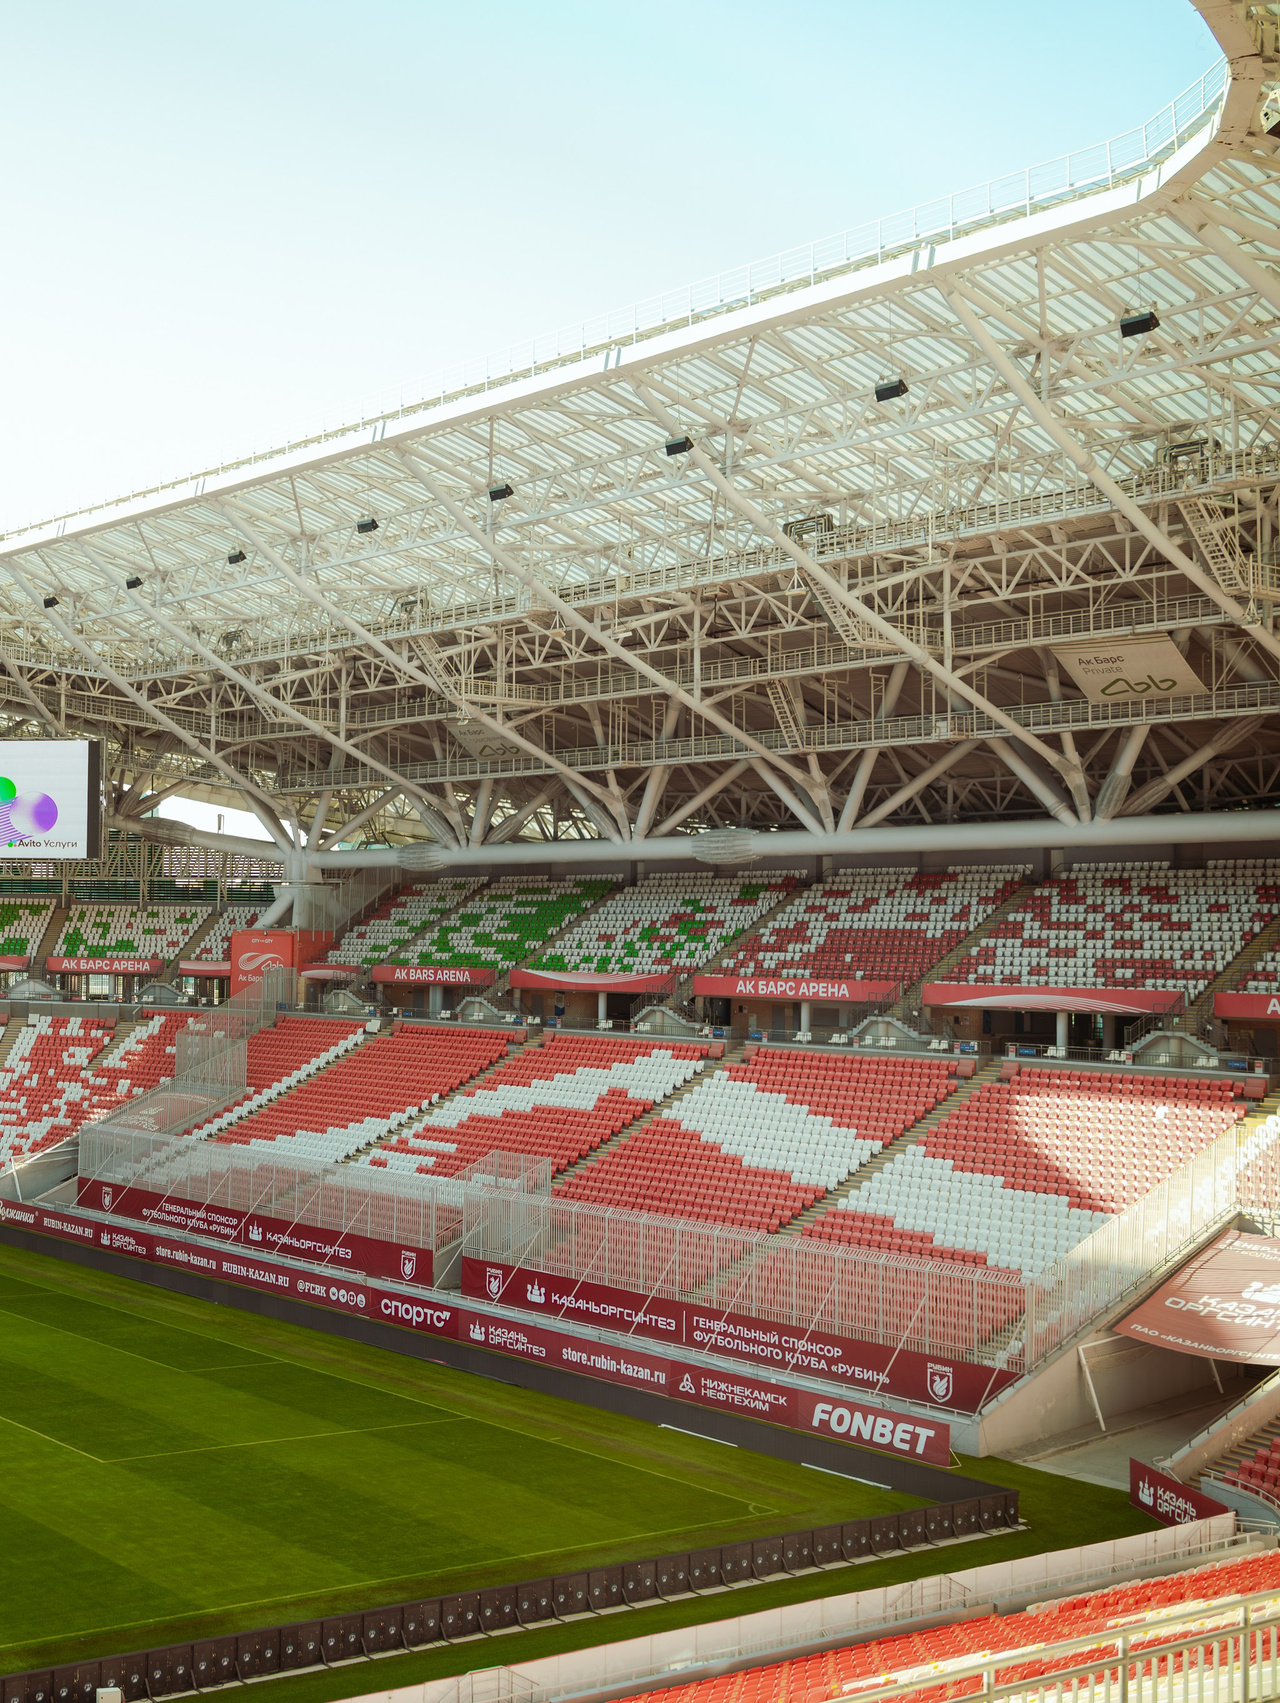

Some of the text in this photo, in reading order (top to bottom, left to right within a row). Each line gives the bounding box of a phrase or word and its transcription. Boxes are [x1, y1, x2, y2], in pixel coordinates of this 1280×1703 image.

[1078, 654, 1125, 666] Ак Барс
[1082, 665, 1123, 676] Private
[17, 840, 77, 849] Avito Услуги
[61, 959, 150, 972] АК БАРС АРЕНА
[394, 968, 471, 982] AK BARS ARENA
[736, 980, 849, 998] АК БАРС АРЕНА
[142, 1207, 238, 1237] ФУТБОЛЬНОГО КЛУБА «РУБИН»
[162, 1202, 238, 1226] ГЕНЕРАЛЬНЫЙ СПОНСОР
[43, 1217, 94, 1239] RUBIN-KAZAN.RU
[112, 1232, 136, 1245] КАЗАНЬ
[112, 1239, 147, 1255] ОРГСИНТЕЗ
[266, 1231, 352, 1260] КАЗАНЬОРГСИНТЕЗ
[156, 1246, 217, 1270] store.rubin-kazan.ru
[222, 1261, 290, 1288] RUBIN-KAZAN.RU
[297, 1279, 327, 1297] @FCRK
[551, 1292, 676, 1331] КАЗАНЬОРГСИНТЕЗ
[488, 1325, 528, 1343] КАЗАНЬ
[693, 1316, 842, 1359] ГЕНЕРАЛЬНЫЙ СПОНСОР
[1130, 1323, 1159, 1336] ПАО
[488, 1335, 546, 1358] ОРГСИНТЕЗ
[693, 1330, 890, 1385] ФУТБОЛЬНОГО КЛУБА «РУБИН»
[562, 1346, 666, 1385] store.rubin-kazan.ru
[927, 1362, 953, 1374] РУБИН
[701, 1377, 787, 1406] НИЖНЕКАМСК
[701, 1387, 770, 1412] НЕФТЕХИМ
[812, 1402, 936, 1455] FONBET
[1157, 1485, 1197, 1517] КАЗАНЬ
